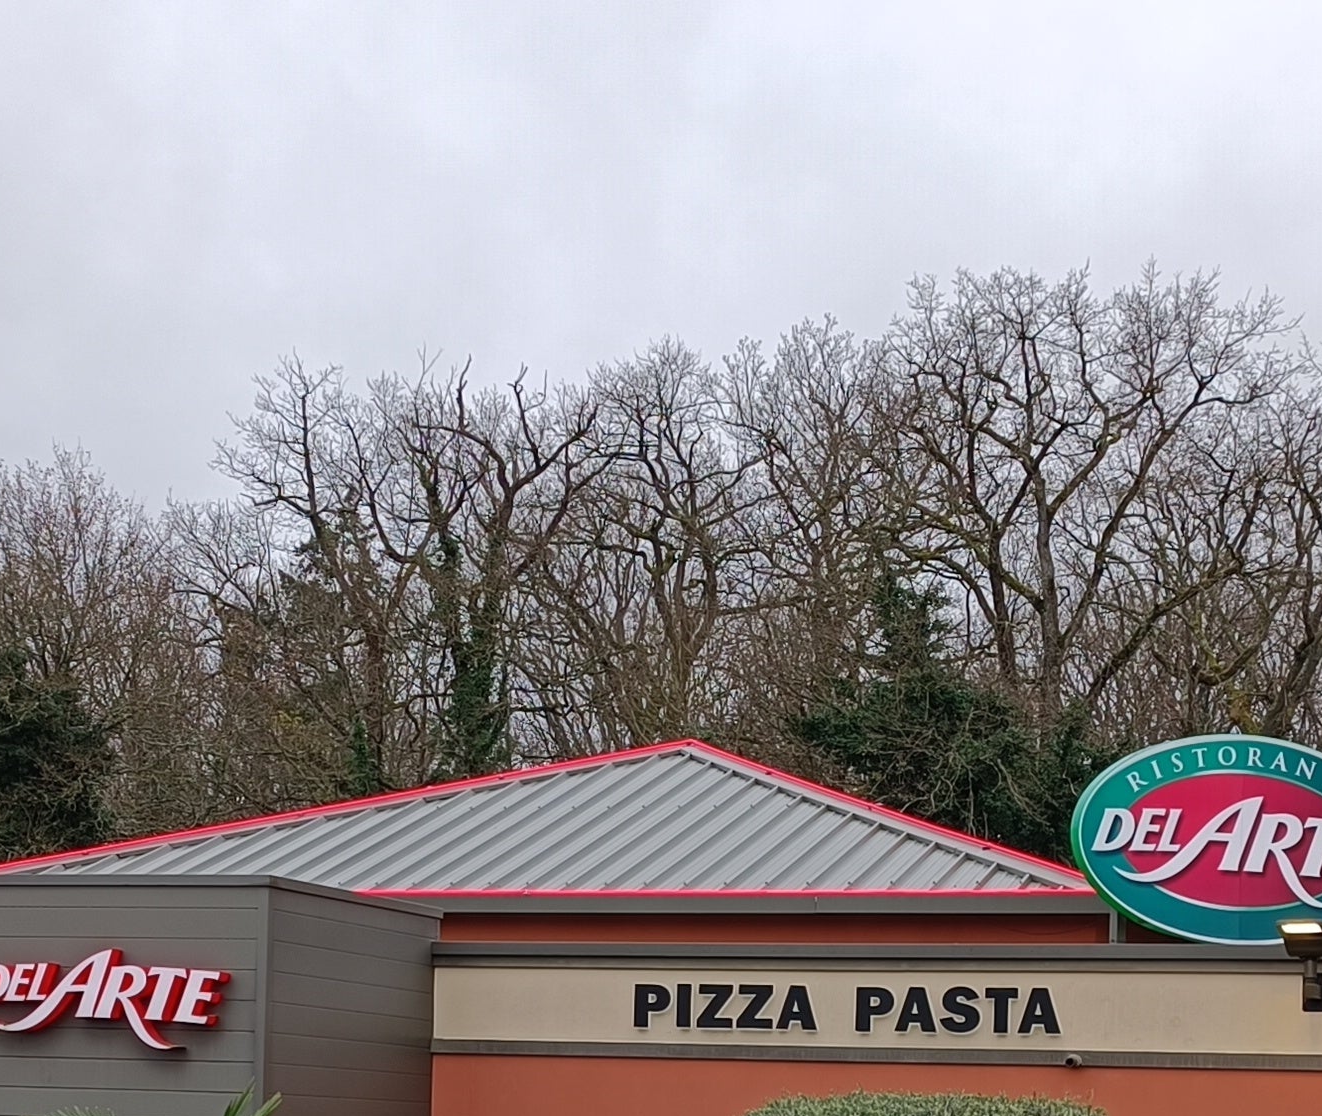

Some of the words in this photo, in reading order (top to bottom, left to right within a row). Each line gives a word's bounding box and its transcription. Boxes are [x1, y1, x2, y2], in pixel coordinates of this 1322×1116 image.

[1091, 808, 1182, 851] DEL
[632, 983, 819, 1031] PIZZA
[854, 986, 1063, 1036] PASTA
